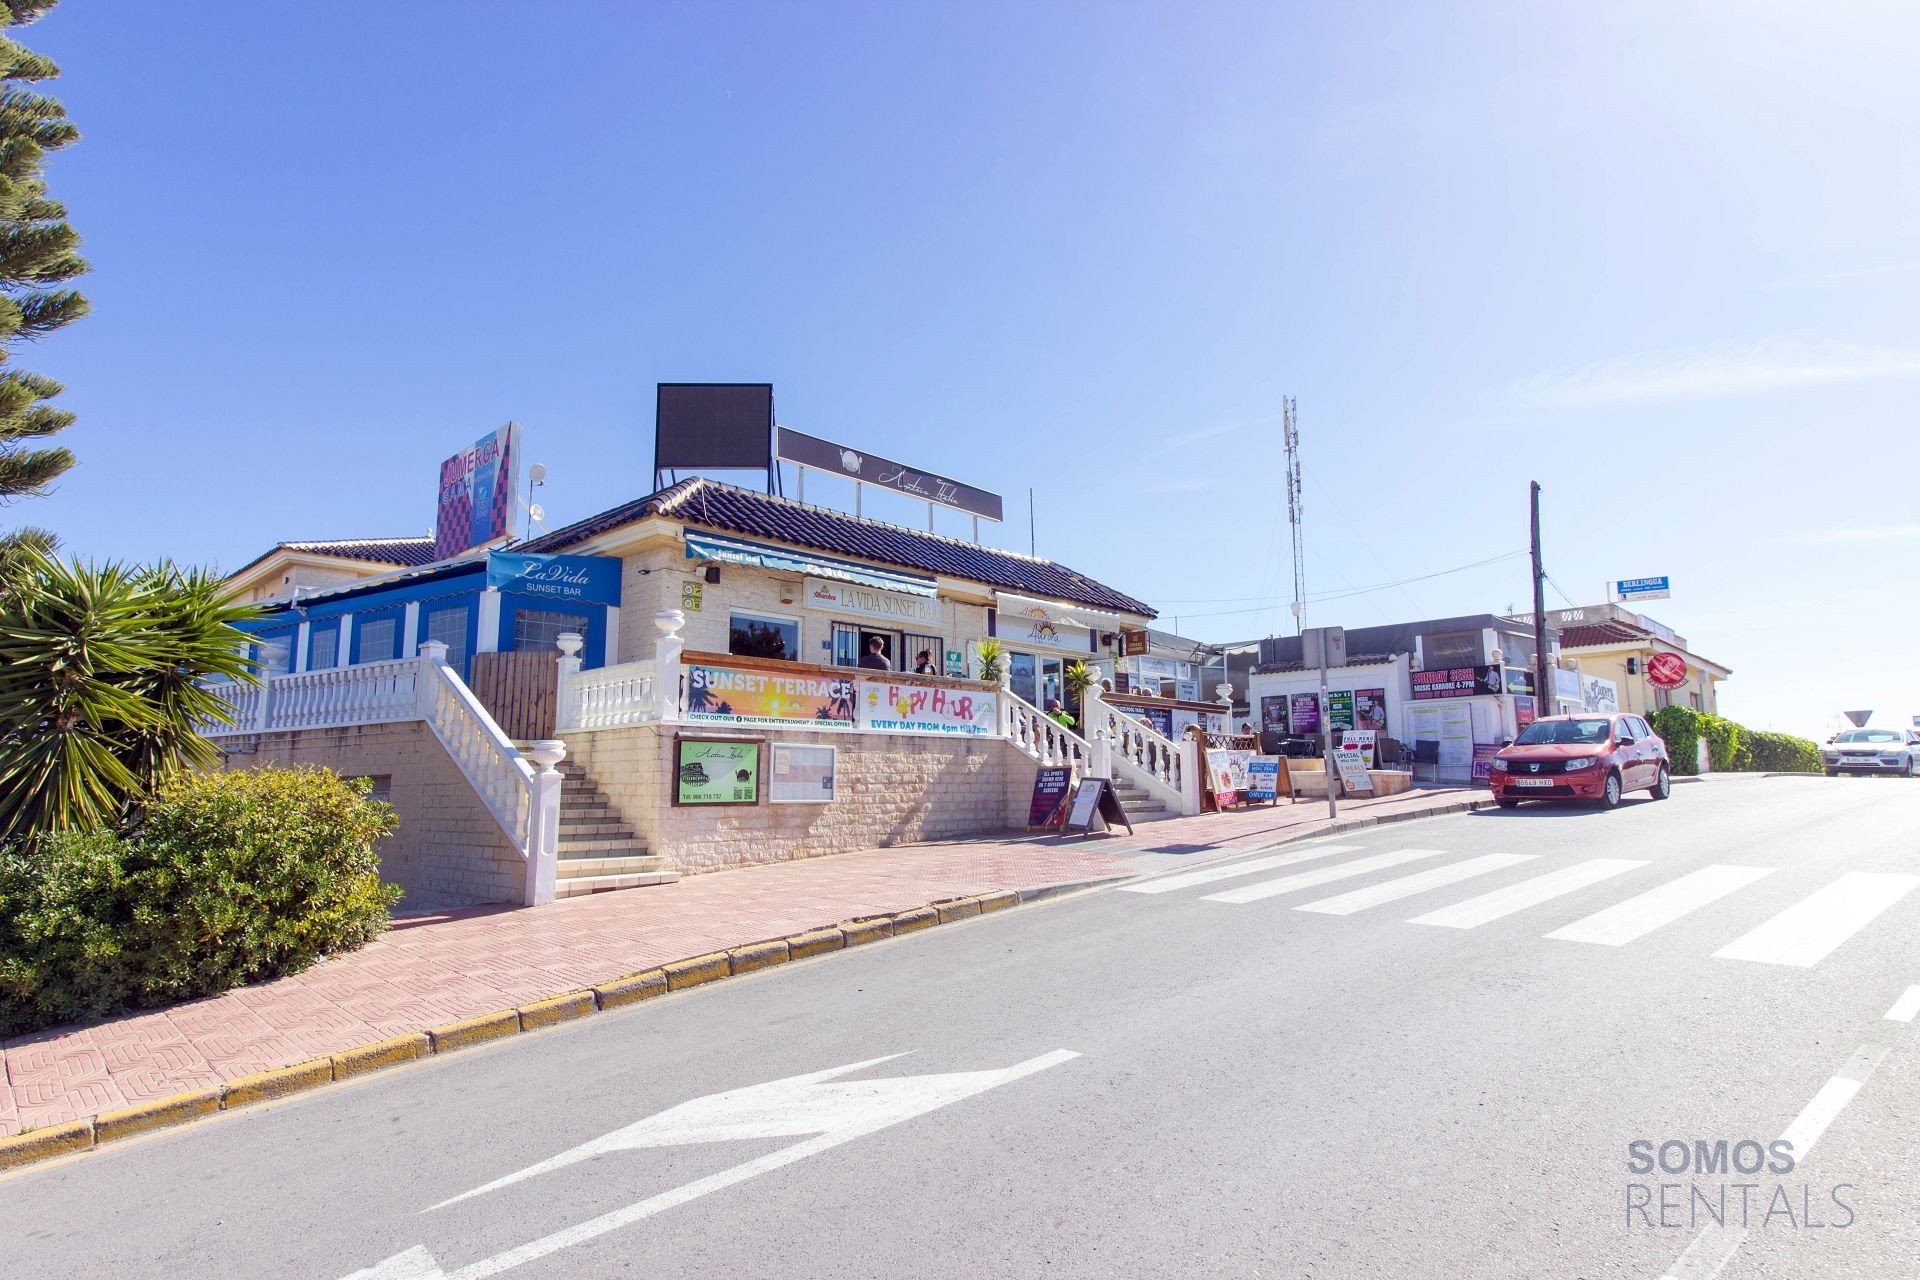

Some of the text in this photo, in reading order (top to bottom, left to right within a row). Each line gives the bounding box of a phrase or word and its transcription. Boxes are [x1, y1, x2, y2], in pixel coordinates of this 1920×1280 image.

[515, 560, 590, 585] La Vida
[526, 582, 581, 596] SUNSET BAR
[1623, 578, 1663, 587] BERLINGUA
[840, 588, 937, 620] LA VIDA SUNSET BAR
[1028, 622, 1062, 644] Aurora
[1412, 668, 1475, 684] SUNDAY SESH
[693, 670, 851, 699] SUNSET TERRACE
[1413, 680, 1475, 692] MUSIC KARAOKE 4-7PM
[871, 719, 898, 729] EVERY
[899, 721, 916, 730] DAY
[917, 722, 940, 731] FROM
[941, 724, 958, 733] 4pm
[959, 725, 971, 734] till
